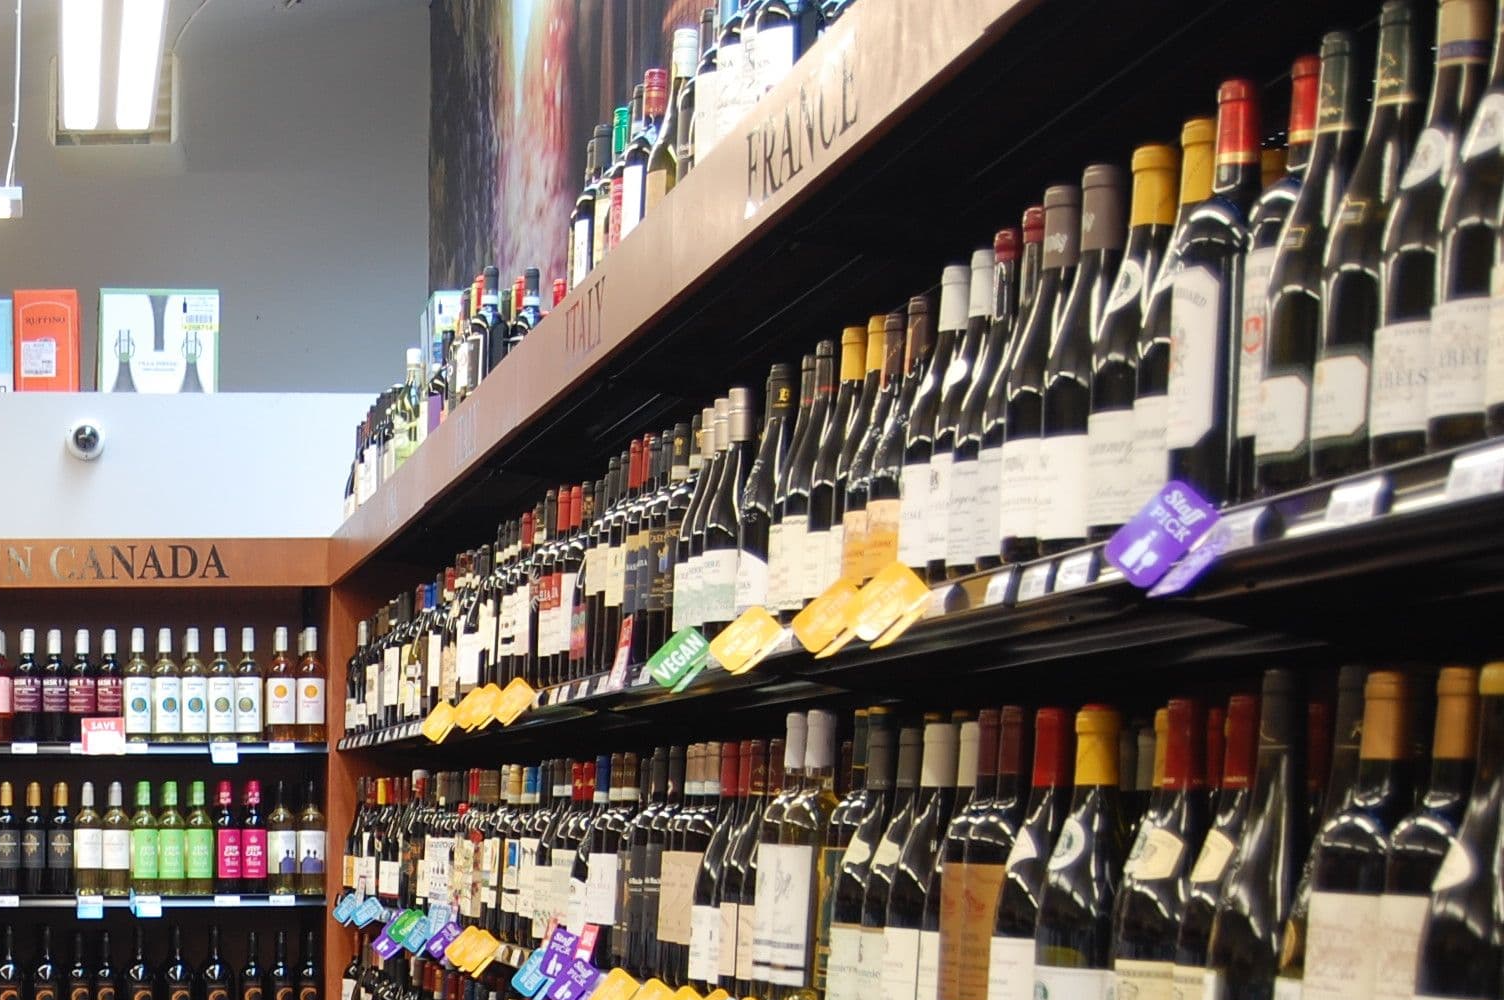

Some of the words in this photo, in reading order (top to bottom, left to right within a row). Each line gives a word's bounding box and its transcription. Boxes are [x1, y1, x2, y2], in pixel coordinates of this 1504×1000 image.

[745, 59, 858, 200] FRANCE
[25, 315, 66, 326] RUFFINO
[565, 277, 605, 355] ITALY
[1164, 488, 1208, 527] Staff
[1148, 503, 1191, 544] PICK
[49, 544, 229, 580] CANADA
[657, 633, 705, 681] VEGAN
[91, 722, 116, 730] SAVE
[550, 942, 572, 956] PICK
[553, 931, 576, 945] Staff
[567, 966, 587, 987] PICK
[576, 959, 595, 978] Staff
